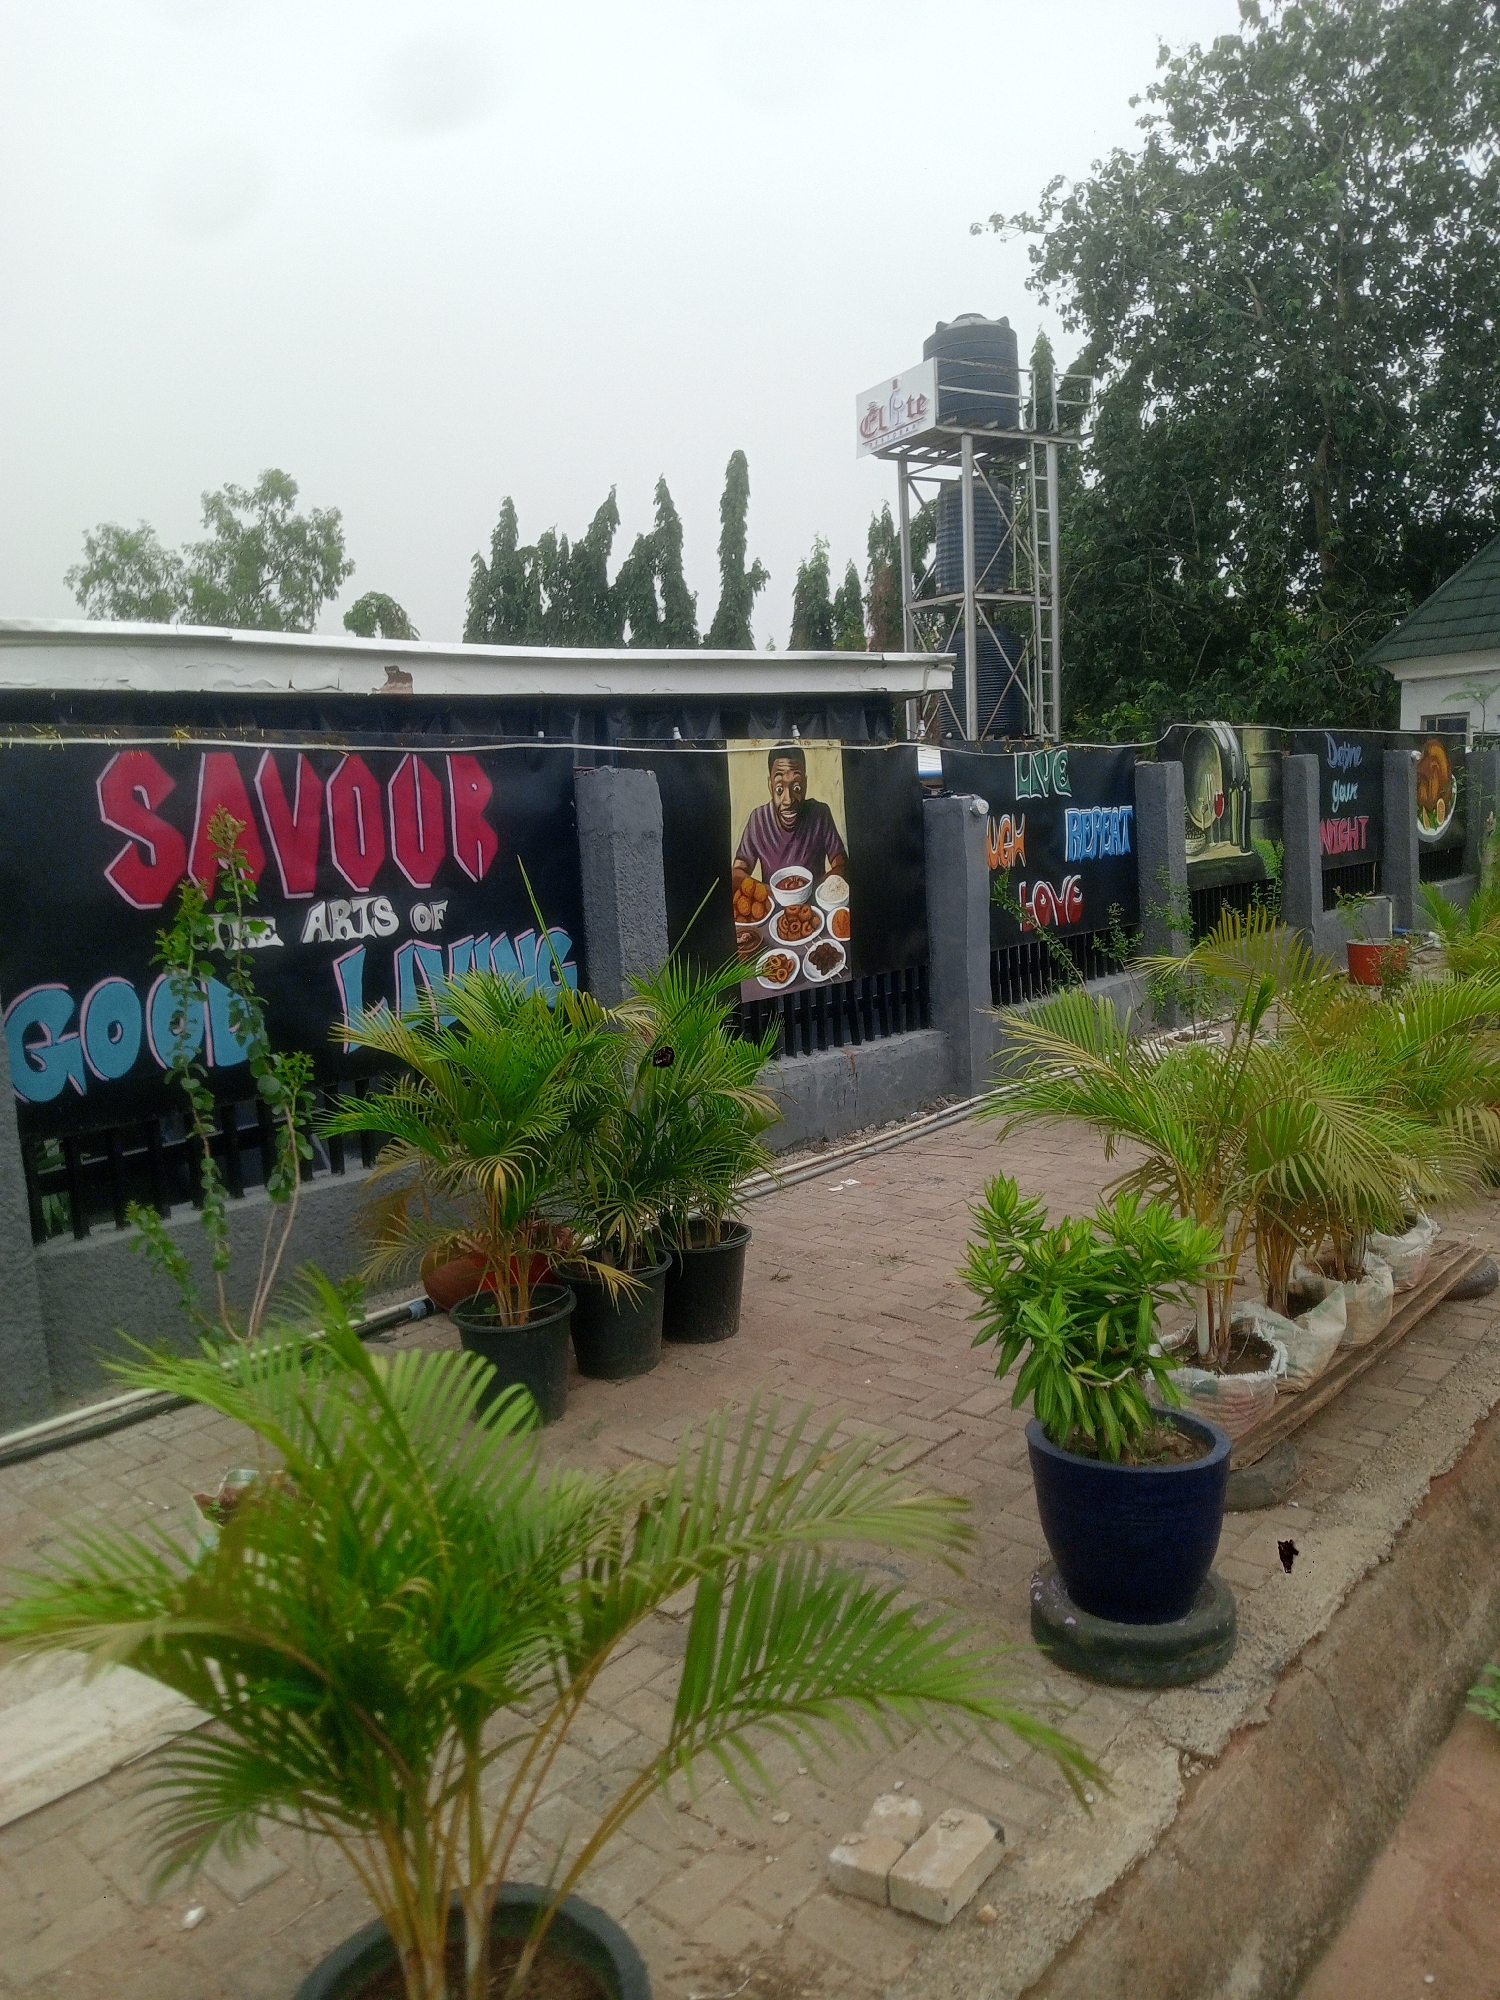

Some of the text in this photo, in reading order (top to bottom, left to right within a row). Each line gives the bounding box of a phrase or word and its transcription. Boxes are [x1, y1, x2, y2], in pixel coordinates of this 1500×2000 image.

[1014, 750, 1072, 800] LIVE
[96, 750, 499, 910] SAVOUR
[986, 813, 1026, 870] UGH
[1065, 805, 1133, 862] REPEAT
[1320, 816, 1369, 856] NIGHT
[302, 896, 400, 944] ARTS
[409, 900, 449, 934] OF
[1019, 875, 1083, 931] LOVE
